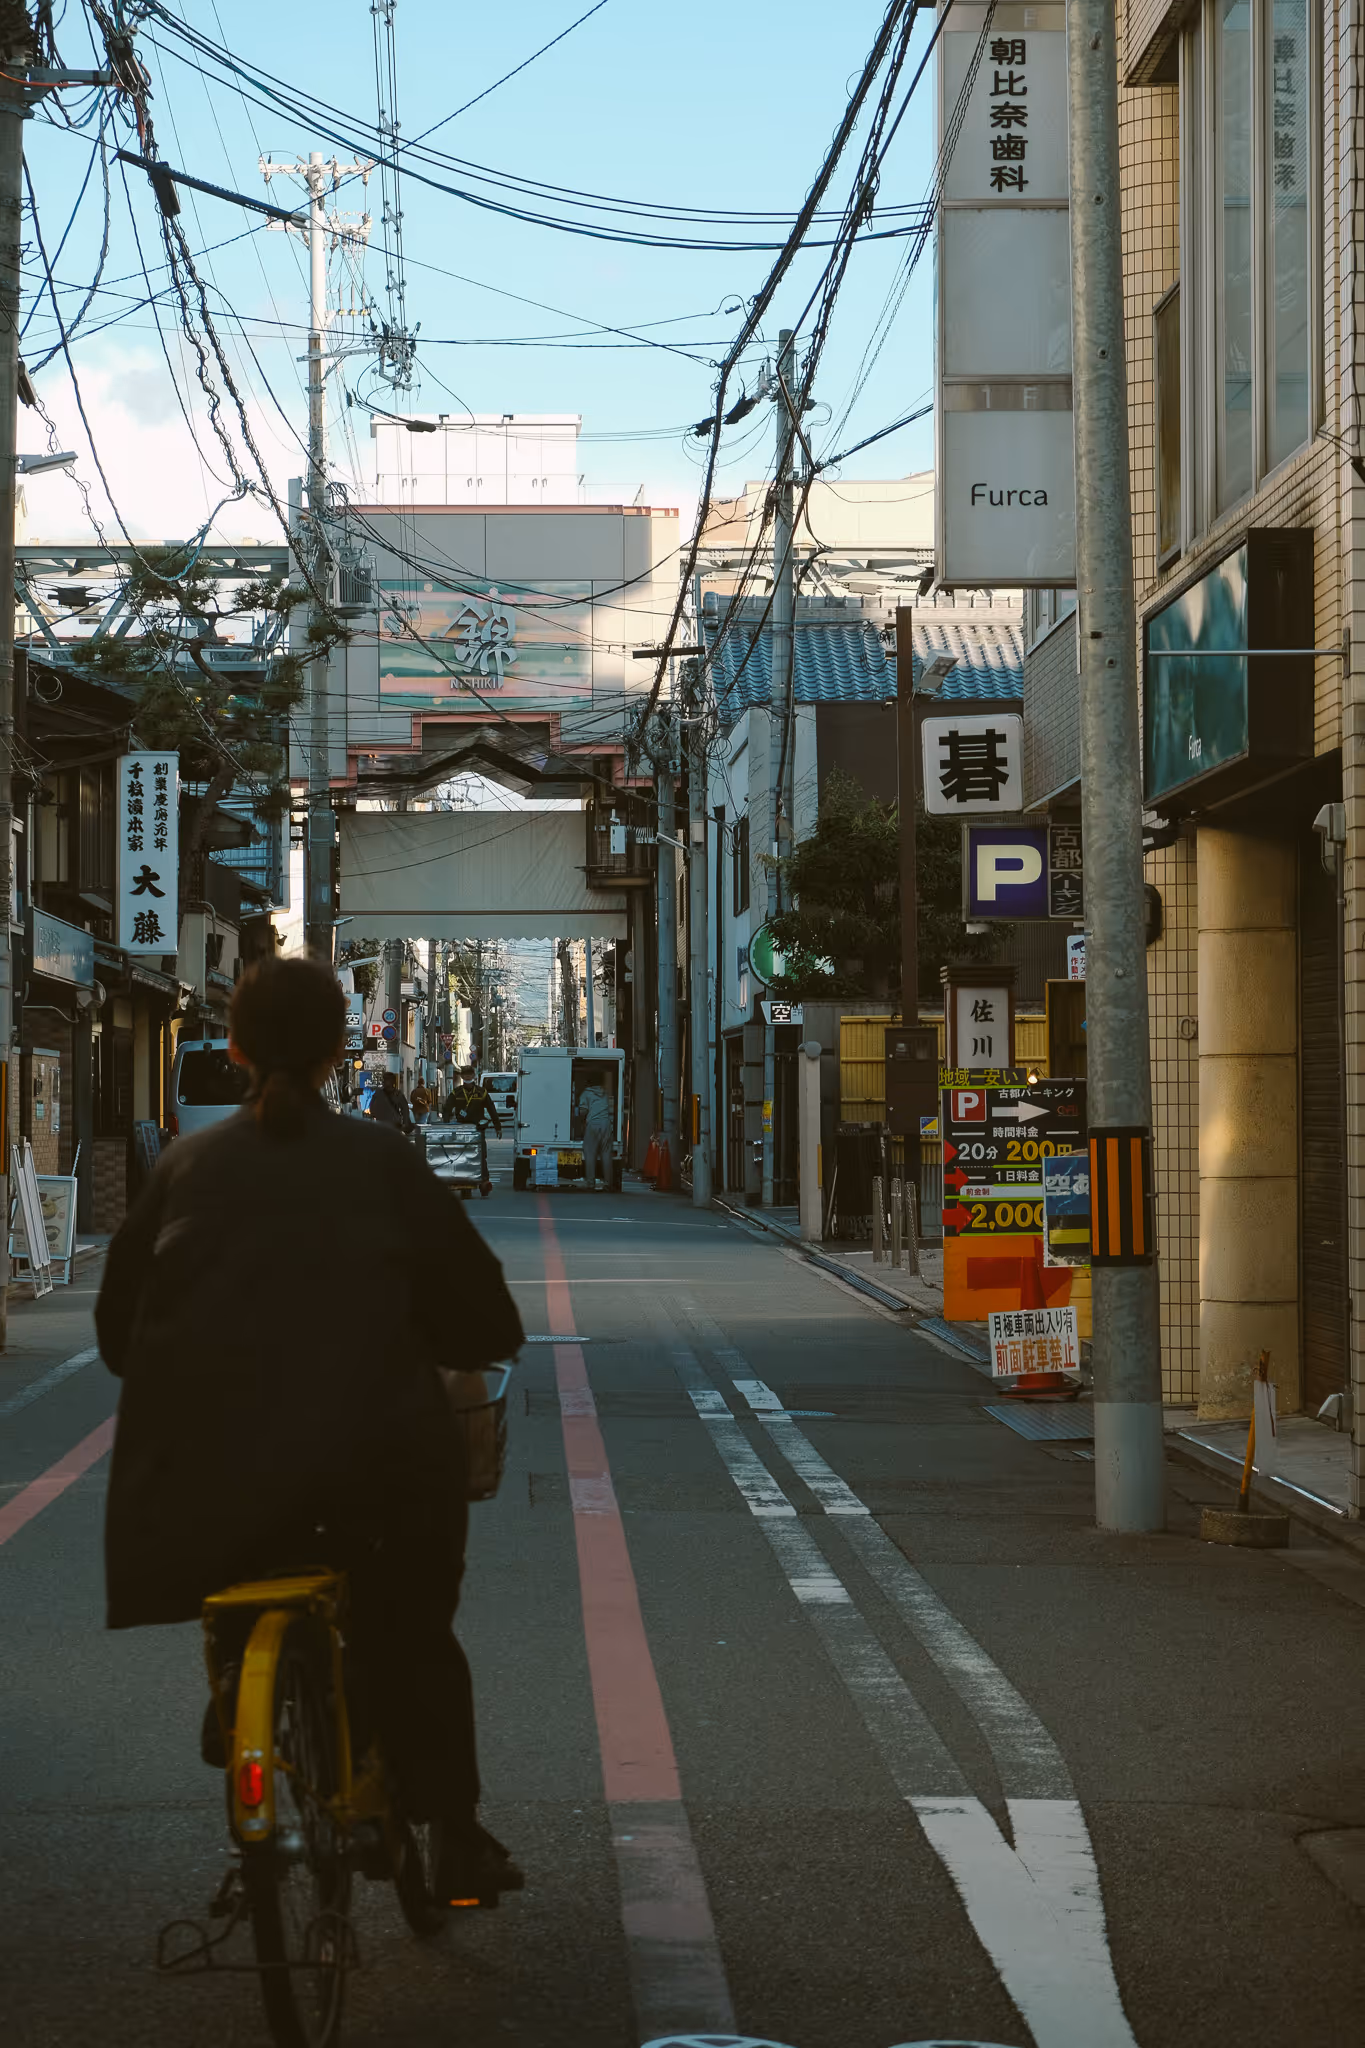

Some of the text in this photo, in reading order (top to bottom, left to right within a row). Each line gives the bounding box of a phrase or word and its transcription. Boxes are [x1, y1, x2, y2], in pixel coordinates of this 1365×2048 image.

[989, 37, 1029, 193] 朝比奈歯科
[971, 483, 1048, 507] Furca
[450, 677, 496, 689] NISHIKI
[939, 728, 1010, 803] 碁
[126, 761, 144, 852] 千枚漬本家
[977, 845, 1043, 901] P
[129, 864, 166, 945] 大藤
[772, 1003, 791, 1022] 空
[372, 1024, 382, 1036] P
[970, 998, 995, 1058] 佐川
[957, 1092, 980, 1118] P
[998, 1088, 1074, 1099] 古都パーキング
[992, 1126, 1039, 1138] 時間料金
[958, 1143, 999, 1161] 20分
[996, 1171, 1040, 1182] 1日料金
[993, 1308, 1073, 1339] 月極車両出入り有
[995, 1335, 1076, 1376] 前面駐車禁止
